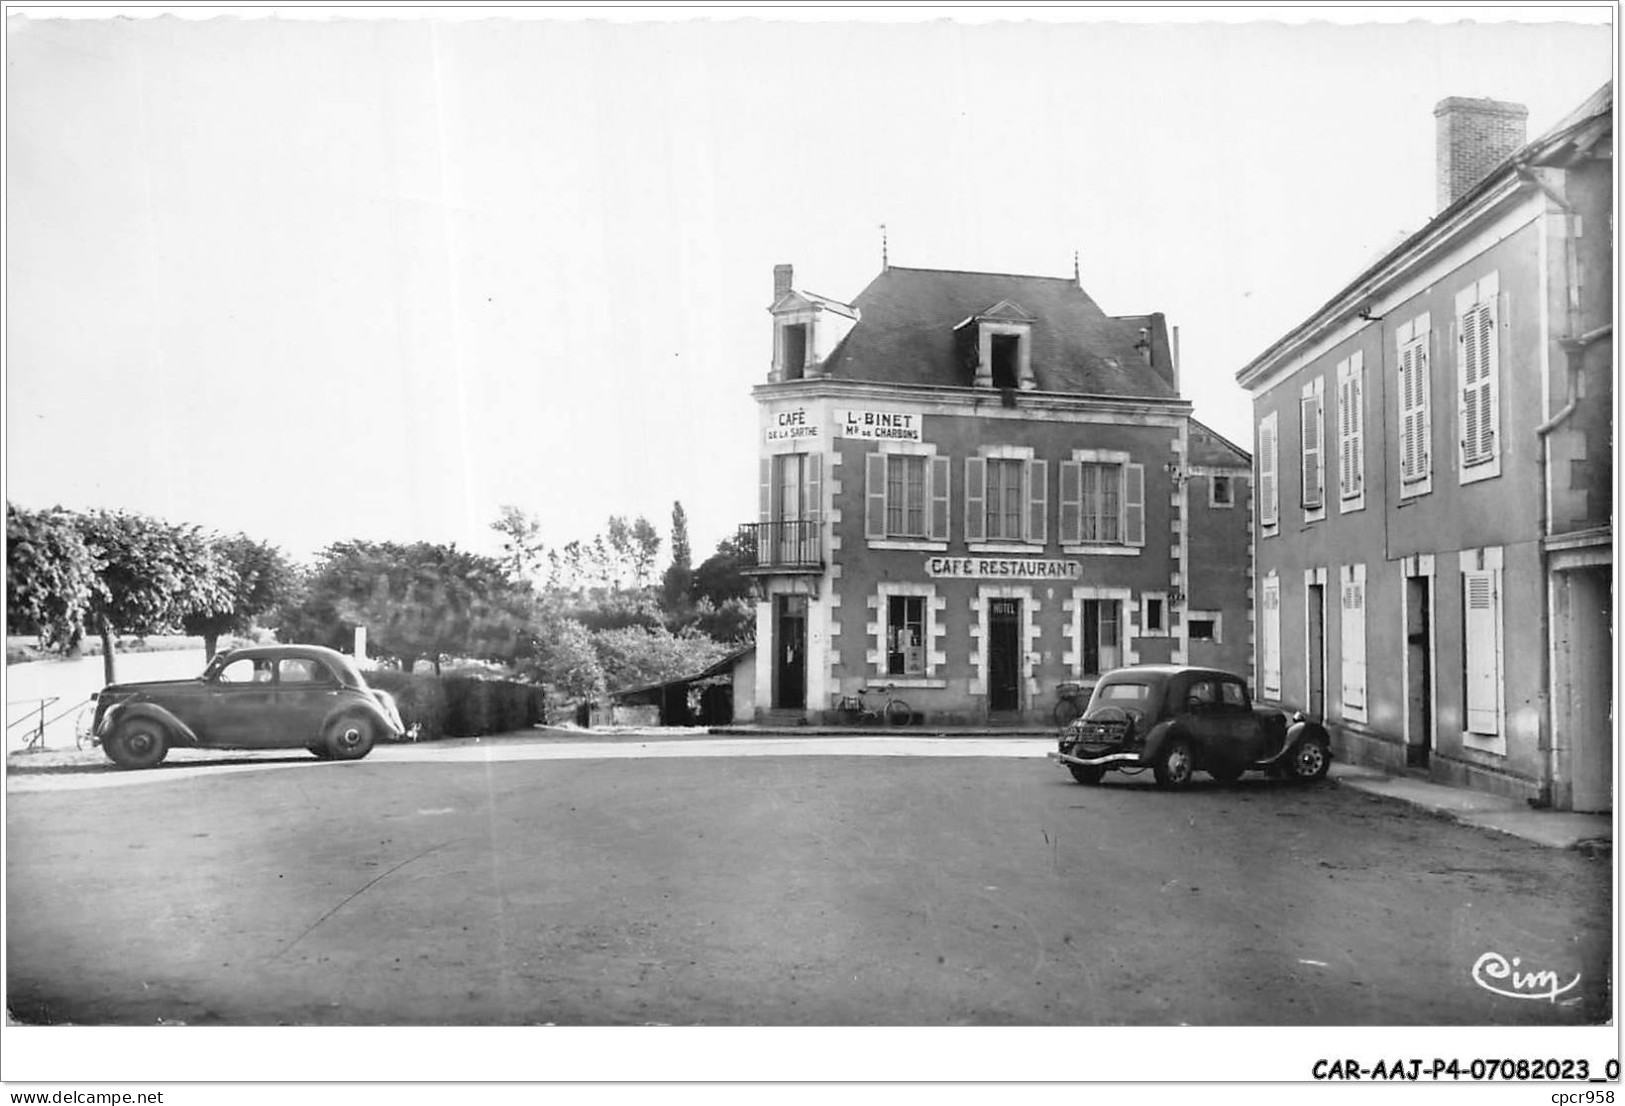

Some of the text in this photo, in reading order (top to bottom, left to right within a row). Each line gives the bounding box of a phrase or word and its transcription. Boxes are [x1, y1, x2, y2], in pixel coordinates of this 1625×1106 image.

[779, 429, 788, 439] LA
[790, 427, 818, 438] SARTHE
[875, 428, 918, 439] CHARBONS
[980, 560, 1076, 576] RESTAURANT
